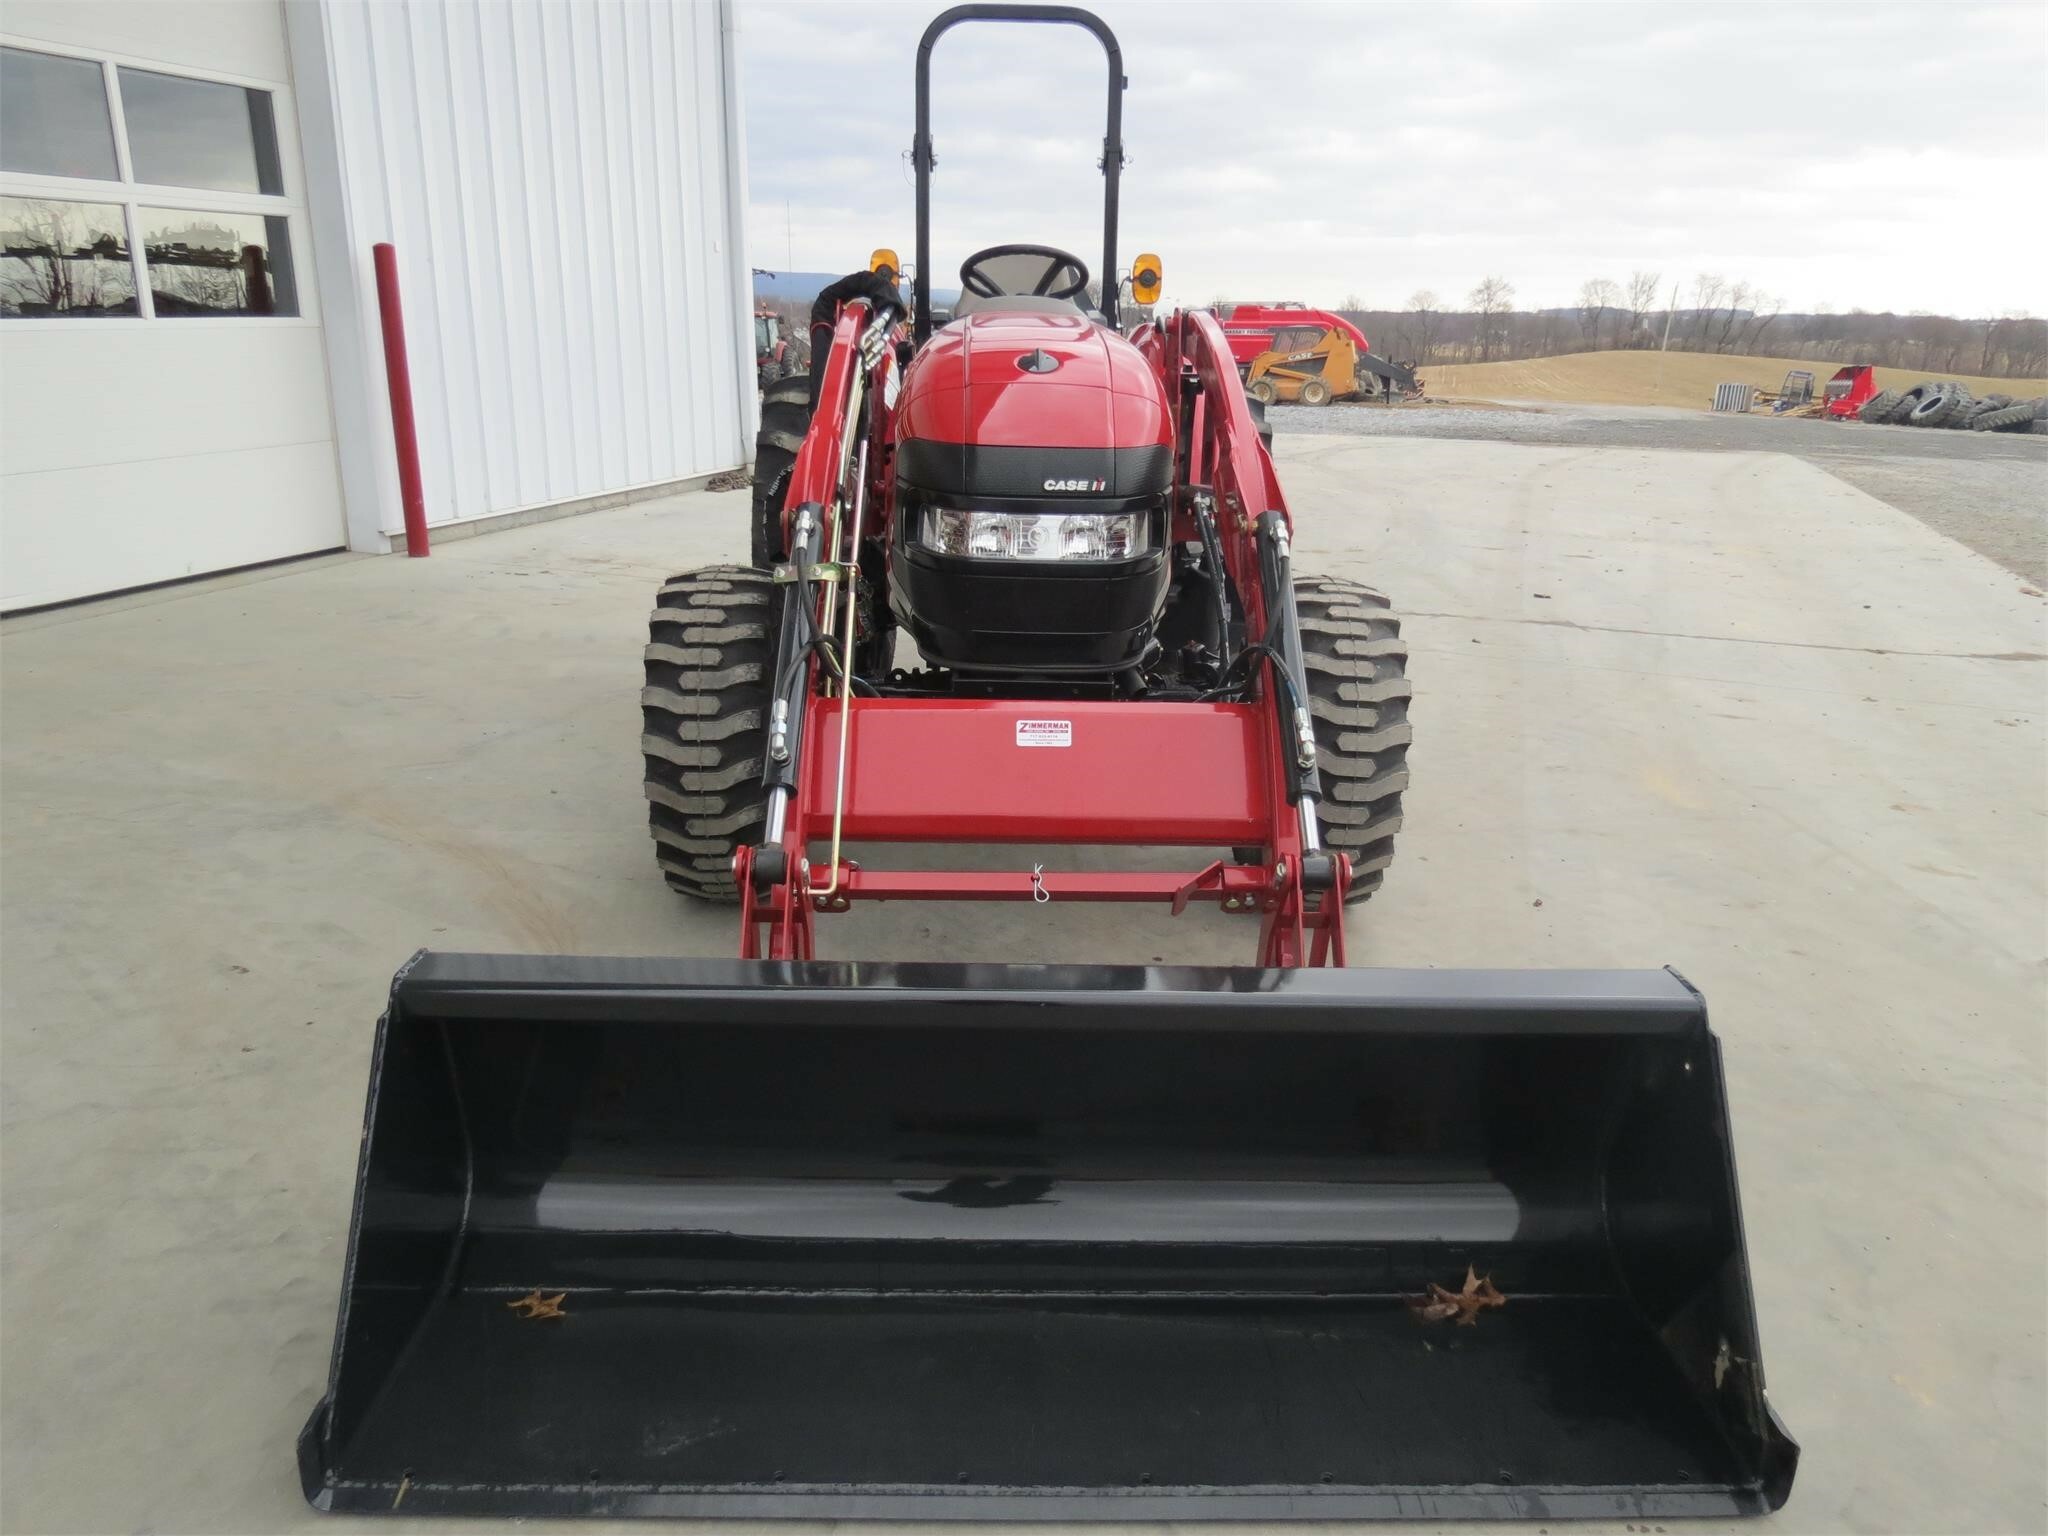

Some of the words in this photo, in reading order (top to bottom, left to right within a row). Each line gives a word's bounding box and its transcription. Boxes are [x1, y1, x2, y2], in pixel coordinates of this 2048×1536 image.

[1287, 353, 1313, 361] CASE
[1043, 479, 1089, 491] CASE
[1019, 722, 1069, 733] ZIMMERMAN
